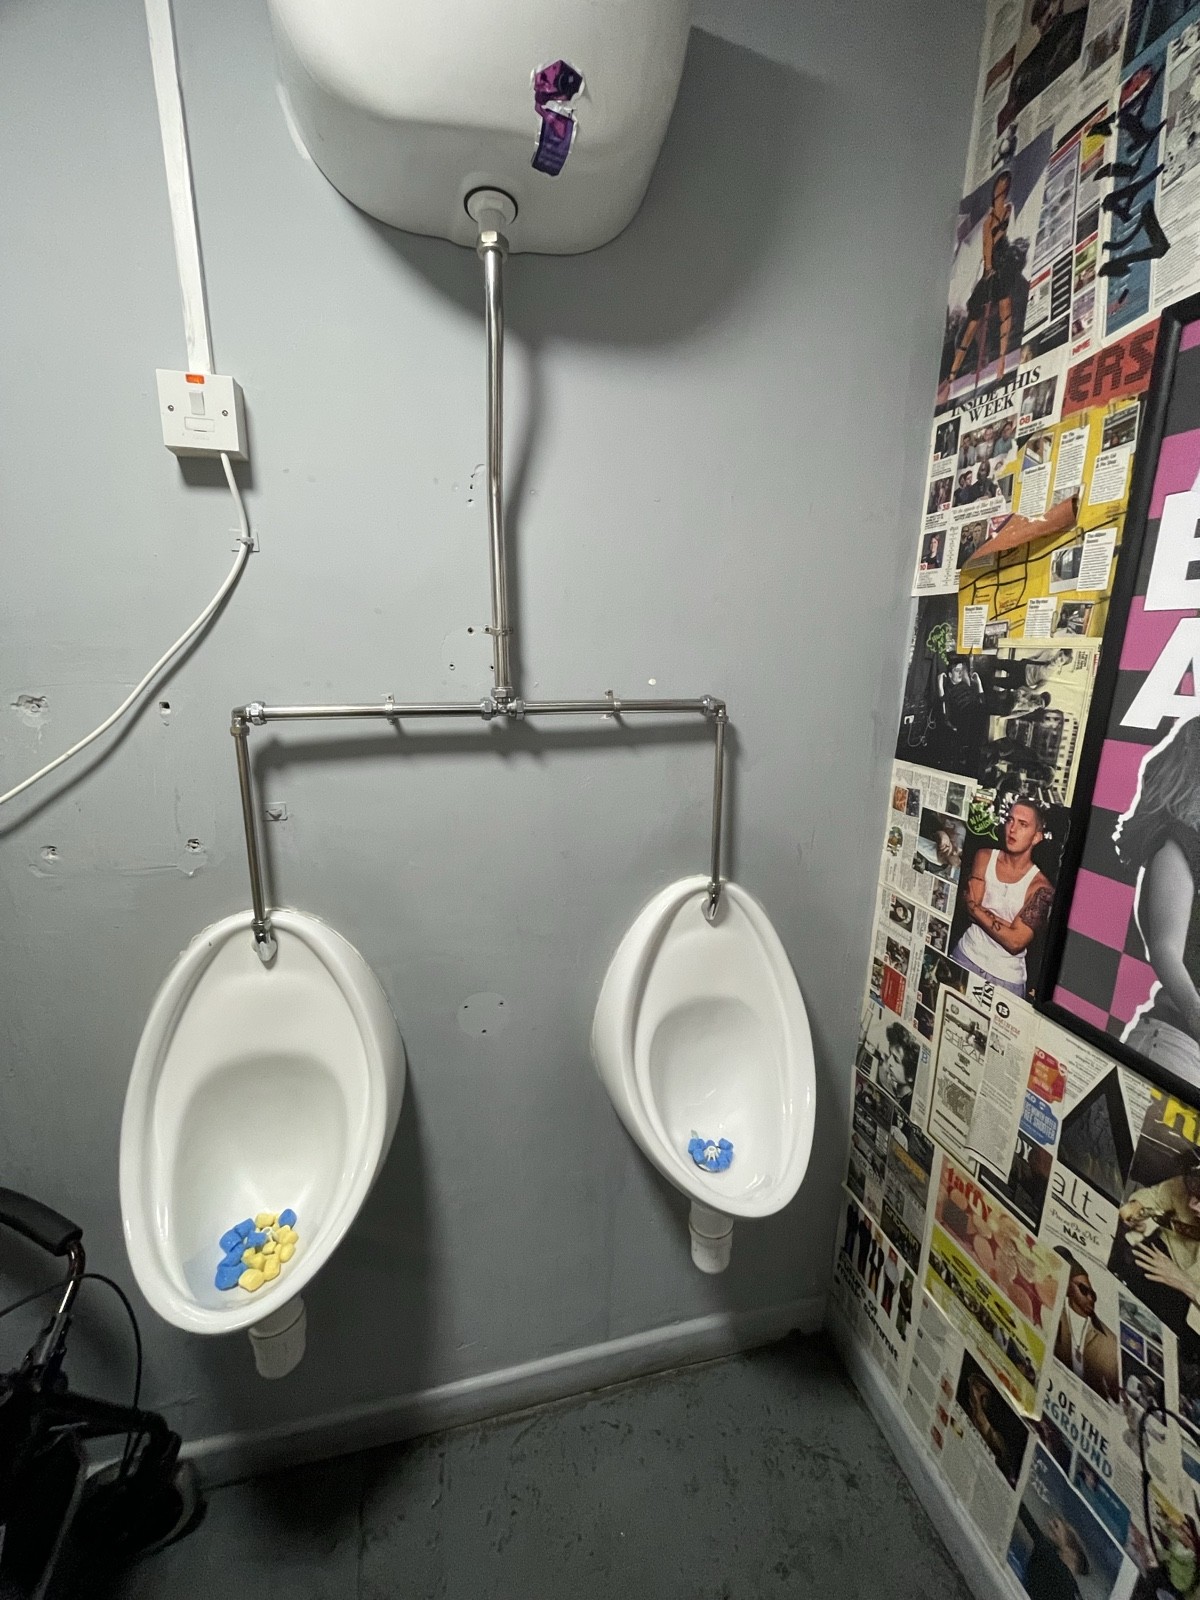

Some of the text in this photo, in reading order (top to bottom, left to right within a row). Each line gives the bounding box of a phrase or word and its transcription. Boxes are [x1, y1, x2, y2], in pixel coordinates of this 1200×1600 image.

[951, 366, 1041, 417] INSIDE THIS
[969, 392, 1015, 423] WEEK
[1063, 1225, 1087, 1247] NAS
[1058, 1390, 1110, 1457] OF THE
